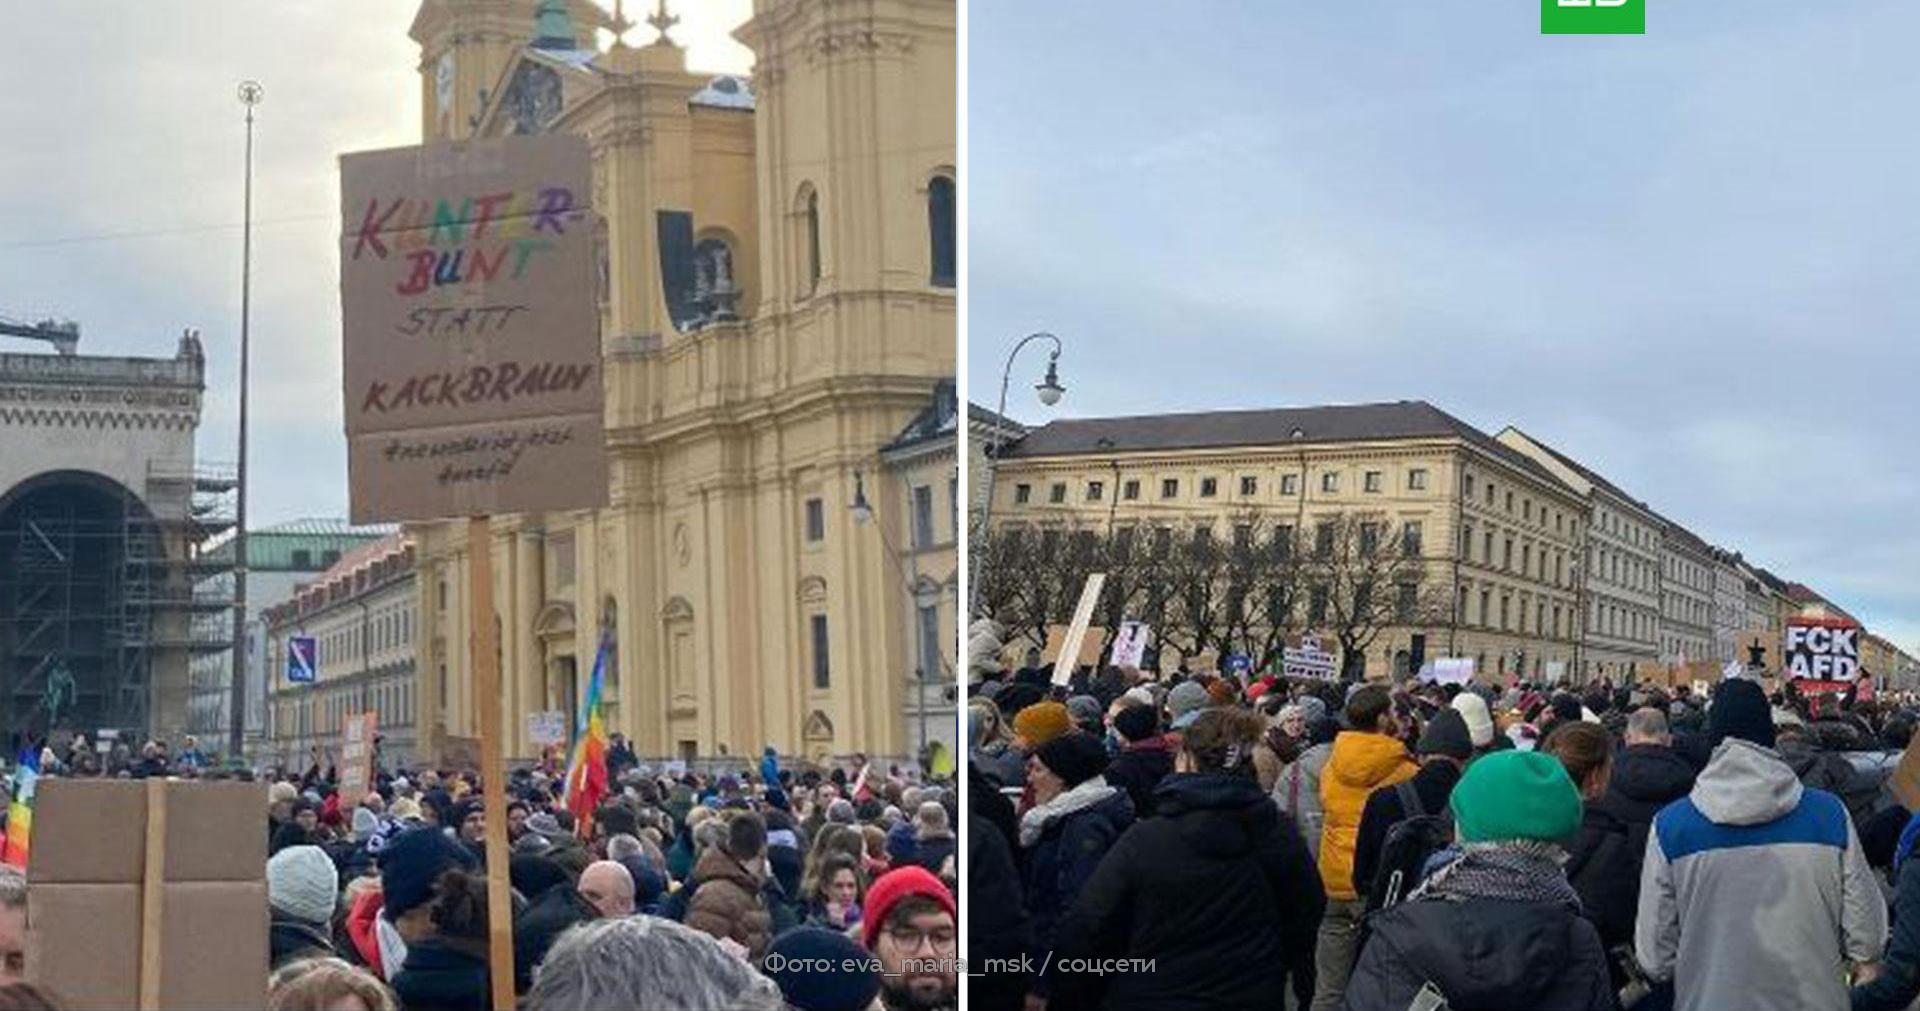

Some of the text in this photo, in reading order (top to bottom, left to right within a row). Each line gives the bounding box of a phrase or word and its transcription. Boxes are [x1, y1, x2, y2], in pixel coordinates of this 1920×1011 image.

[354, 187, 583, 259] KUNTER-
[397, 240, 551, 295] BUNT
[397, 305, 529, 336] STATT
[363, 362, 594, 413] KACKBRAUN
[1787, 626, 1856, 655] FCK
[1790, 653, 1855, 680] AFD
